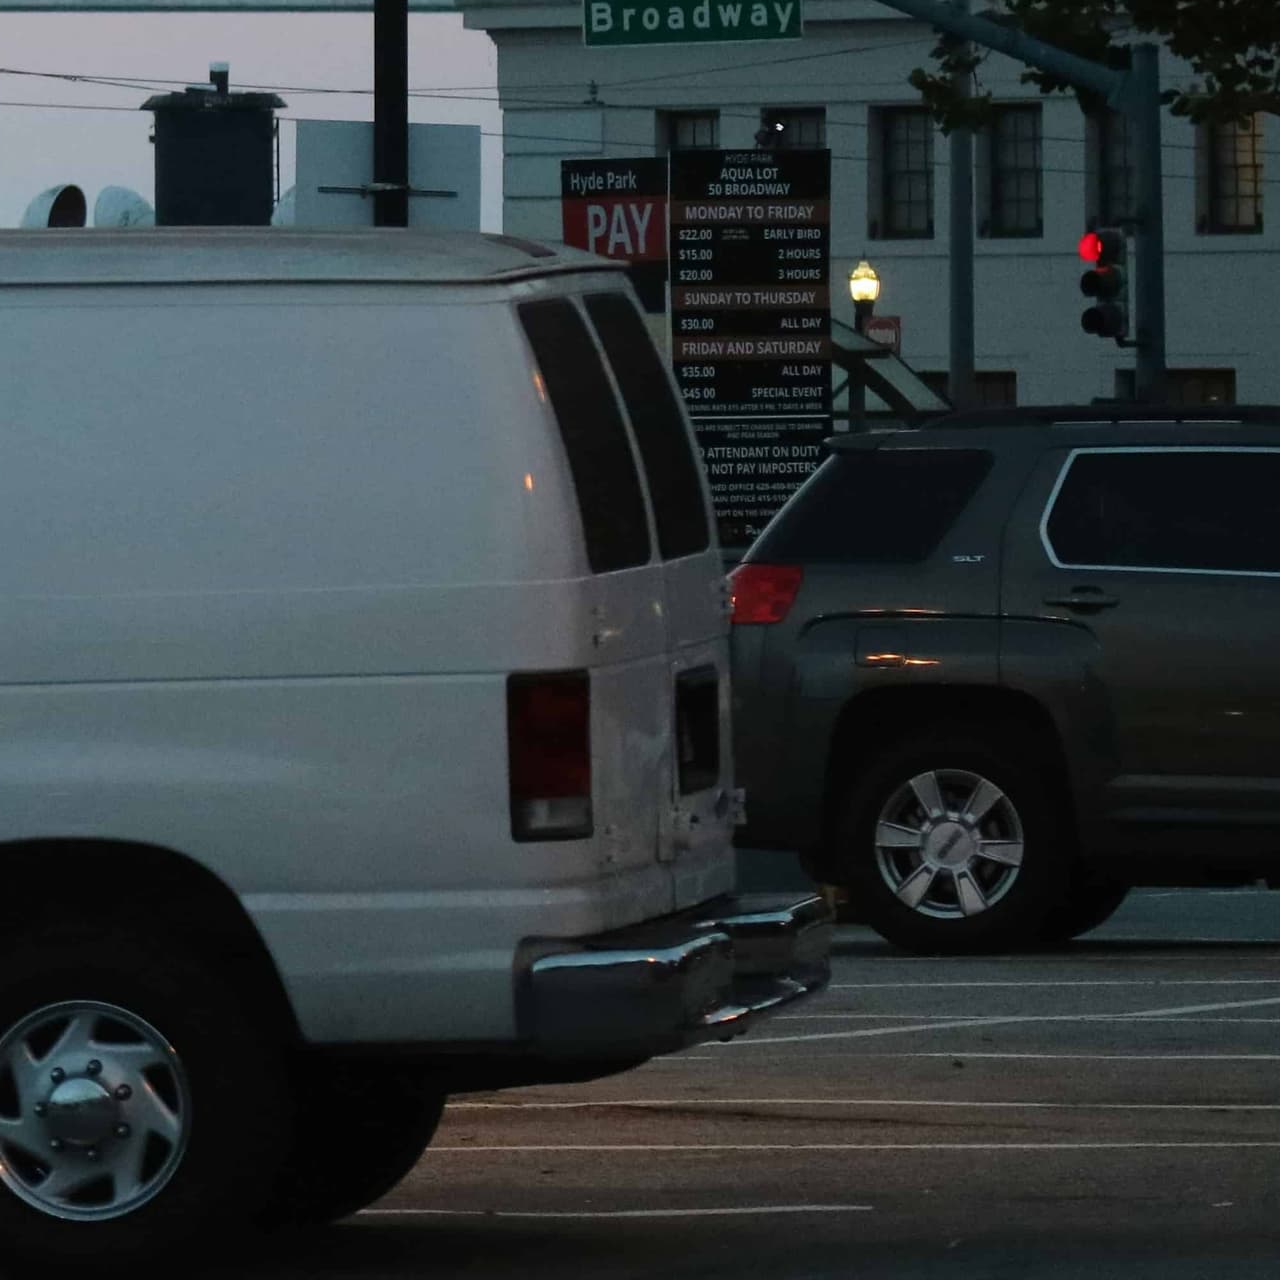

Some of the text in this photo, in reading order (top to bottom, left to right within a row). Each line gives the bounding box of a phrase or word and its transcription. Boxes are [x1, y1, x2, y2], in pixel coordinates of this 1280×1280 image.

[720, 168, 779, 181] AQUA LOT
[570, 169, 637, 196] Hyde Park
[708, 183, 791, 195] 50 BROADWAY
[685, 205, 815, 220] MONDAY TO FRIDAY
[587, 203, 653, 254] PAY
[679, 229, 713, 241] $22.00
[763, 228, 795, 240] EARLY
[796, 228, 821, 240] BIRD
[679, 248, 821, 260] $15.00 2 HOURS
[679, 269, 821, 281] $20.00 3 HOURS
[684, 291, 816, 305] SUNDAY TO THURSDAY
[681, 317, 822, 330] $30.00 ALL DAY
[681, 341, 822, 356] FRIDAY AND SATURDAY
[681, 365, 823, 378] $35.00 ALL DAY
[751, 387, 790, 398] SPECIAL
[792, 386, 823, 398] EVENT
[707, 447, 769, 458] ATTENDANT
[772, 446, 789, 458] ON
[791, 446, 821, 457] DUTY
[711, 463, 735, 475] NOT
[736, 463, 756, 474] PAY
[758, 462, 817, 474] IMPOSTERS
